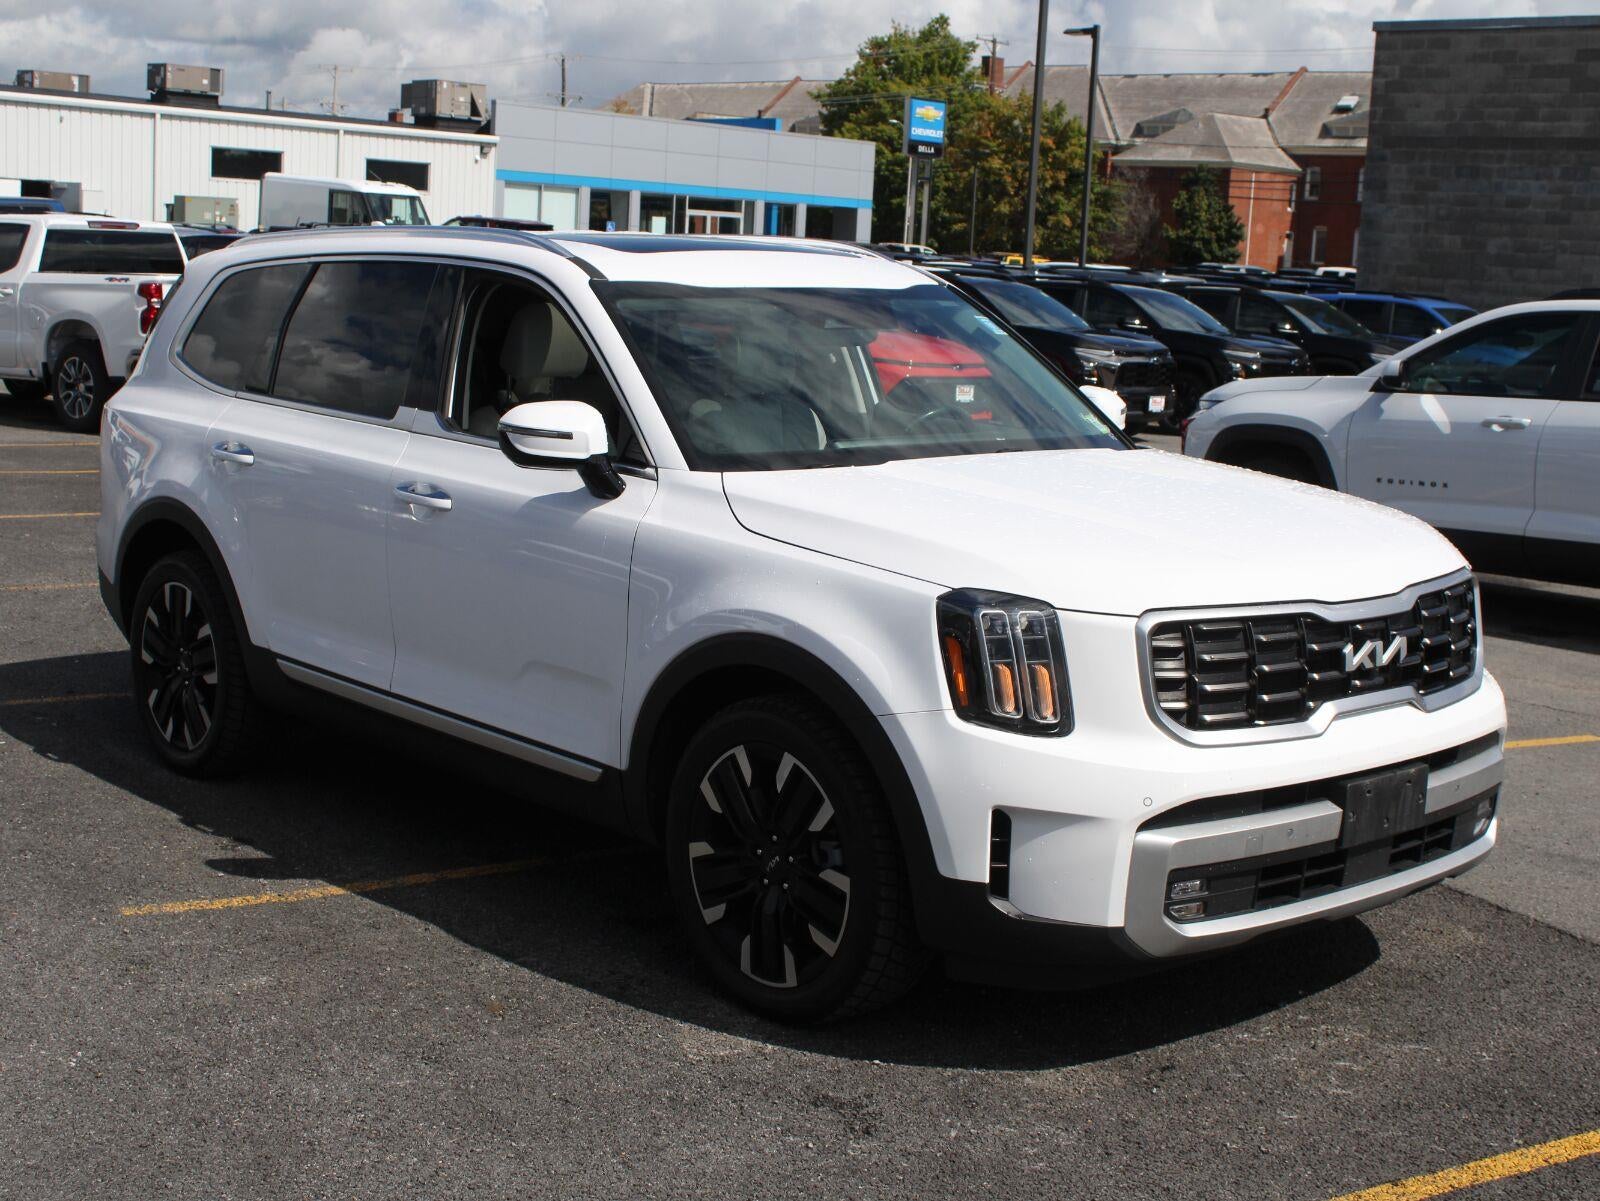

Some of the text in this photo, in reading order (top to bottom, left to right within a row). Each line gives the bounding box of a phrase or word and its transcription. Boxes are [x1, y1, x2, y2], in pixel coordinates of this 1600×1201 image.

[911, 127, 944, 138] CHEVROLET
[918, 145, 935, 153] DELLA
[1376, 477, 1448, 489] EQUINOX
